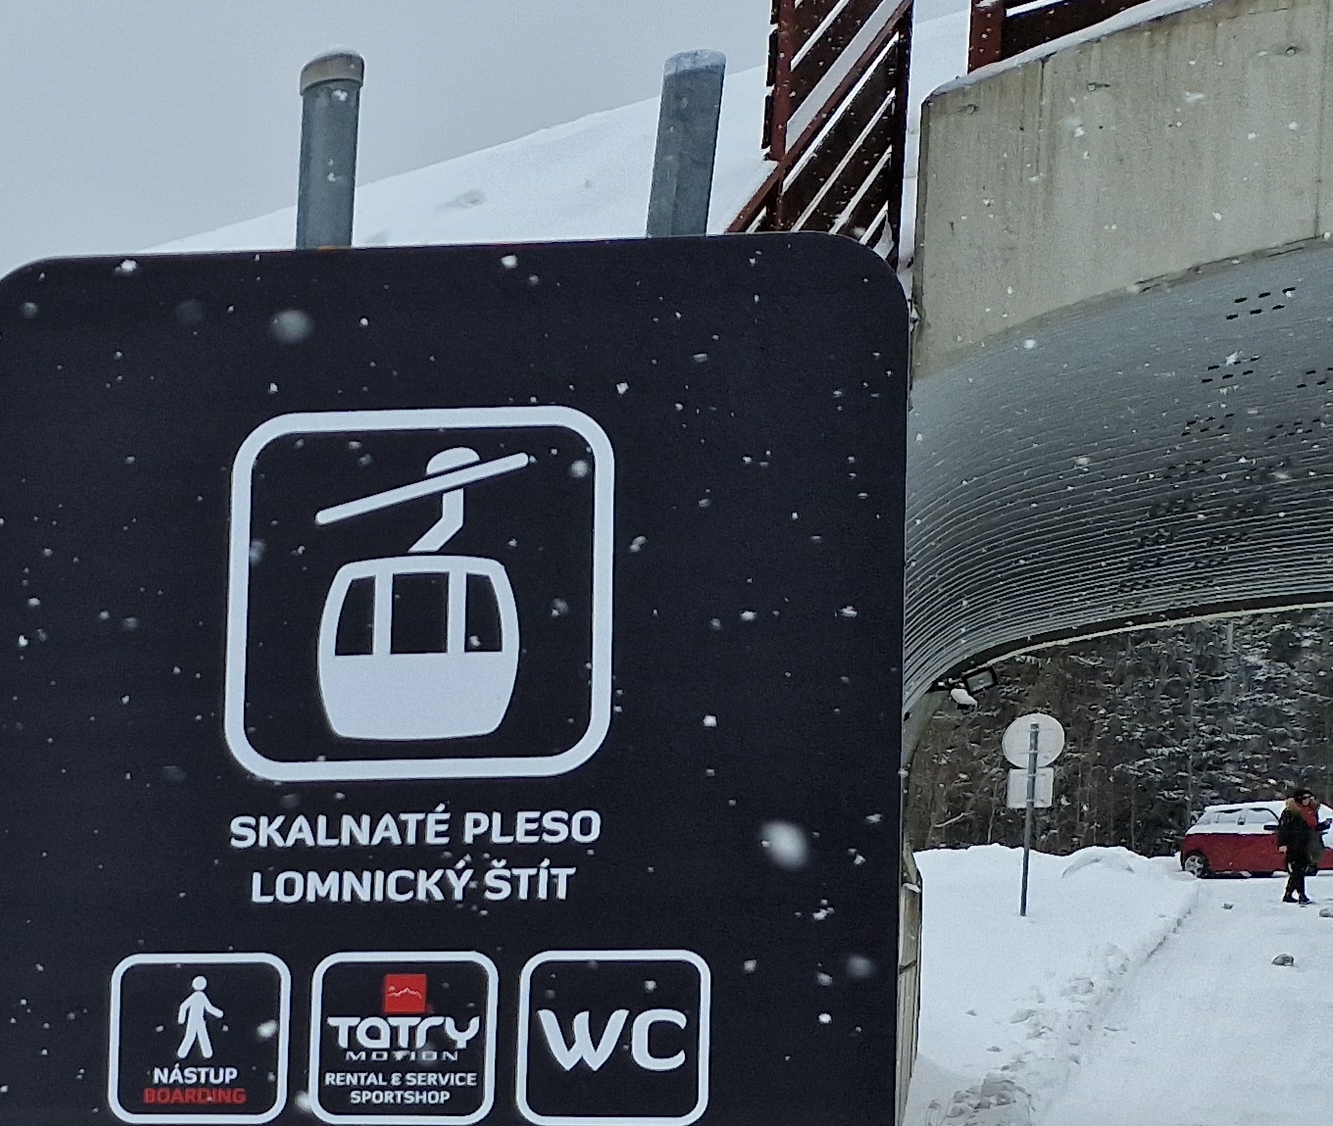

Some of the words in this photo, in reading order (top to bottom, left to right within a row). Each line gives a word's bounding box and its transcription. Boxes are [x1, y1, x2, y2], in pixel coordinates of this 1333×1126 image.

[230, 803, 451, 848] SKALNATÉ
[464, 810, 601, 845] PLESO
[251, 858, 475, 903] LOMNICKÝ
[483, 858, 576, 901] ŠTÍT
[537, 1008, 687, 1072] WC
[345, 1051, 458, 1061] MOTION
[154, 1063, 238, 1084] NÁSTUP
[325, 1073, 387, 1086] RENTAL
[391, 1073, 402, 1086] &
[405, 1073, 477, 1086] SERVICE
[143, 1088, 247, 1104] BOARDING
[350, 1090, 450, 1104] SPORTSHOP
